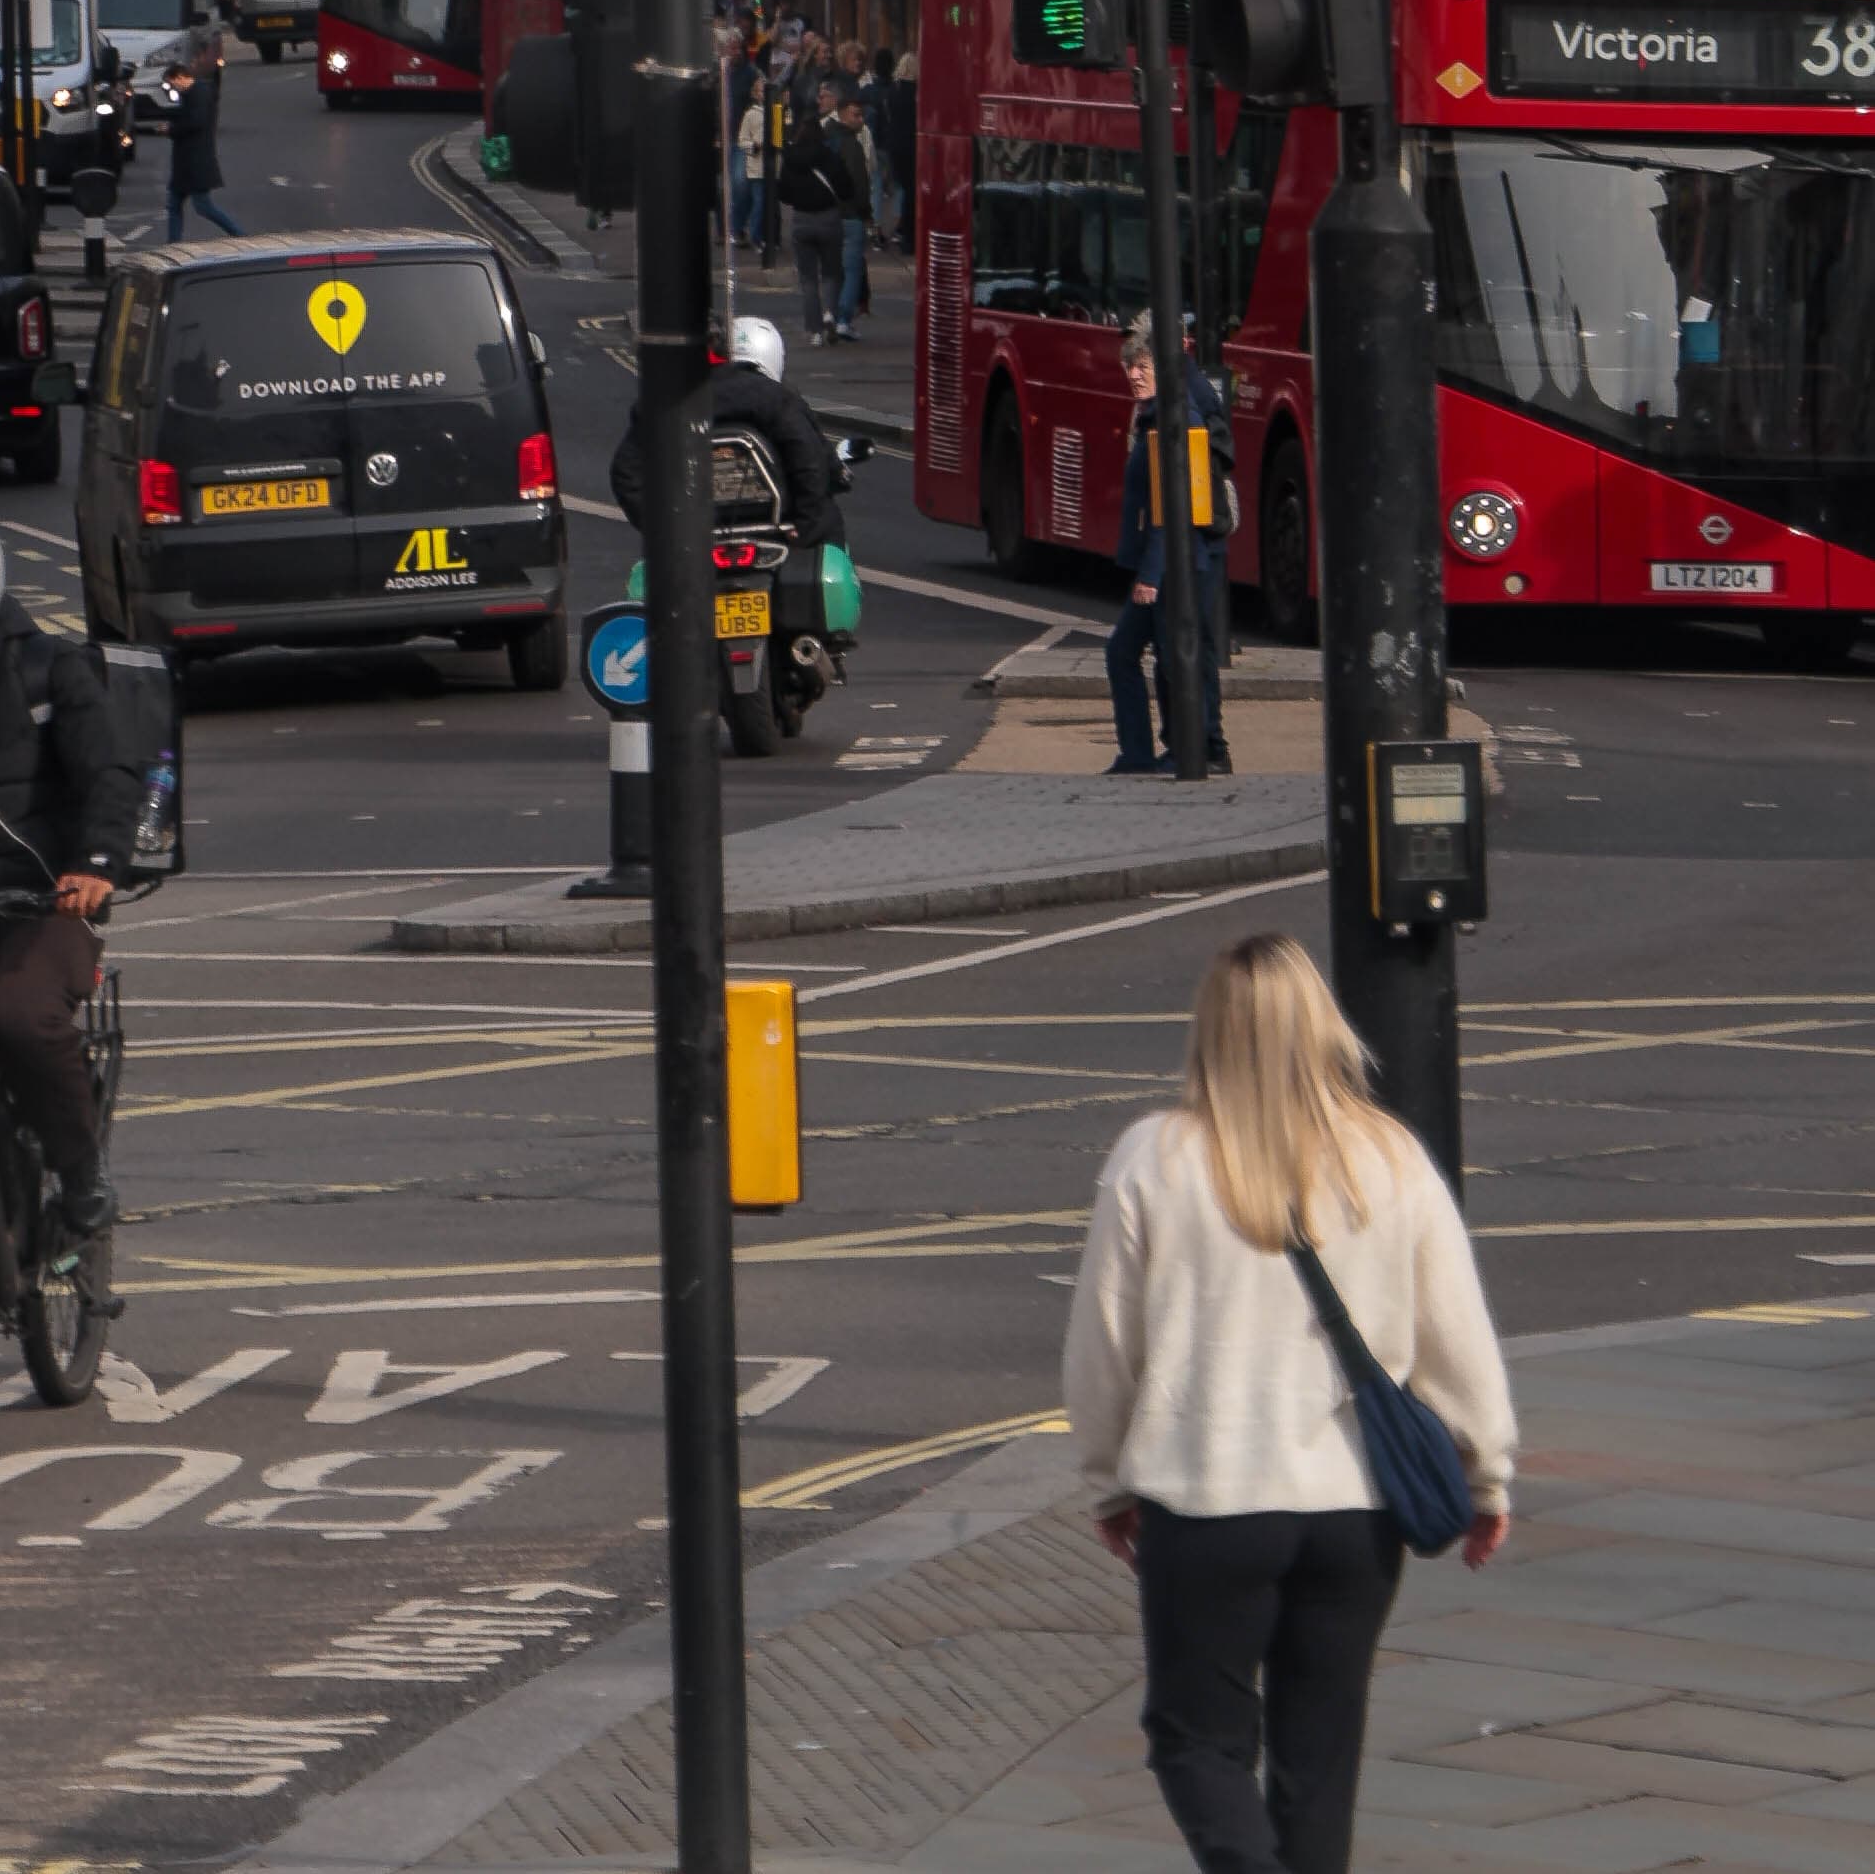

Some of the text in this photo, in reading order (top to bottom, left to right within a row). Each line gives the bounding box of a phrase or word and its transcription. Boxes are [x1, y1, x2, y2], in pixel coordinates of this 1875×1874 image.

[1552, 11, 1875, 78] Victoria 38
[239, 370, 447, 399] DOWNLOAD THE APP
[212, 484, 271, 509] GK24
[384, 571, 478, 590] ADDISON LEE
[1663, 567, 1759, 588] LTZ 1204
[715, 594, 767, 617] F69
